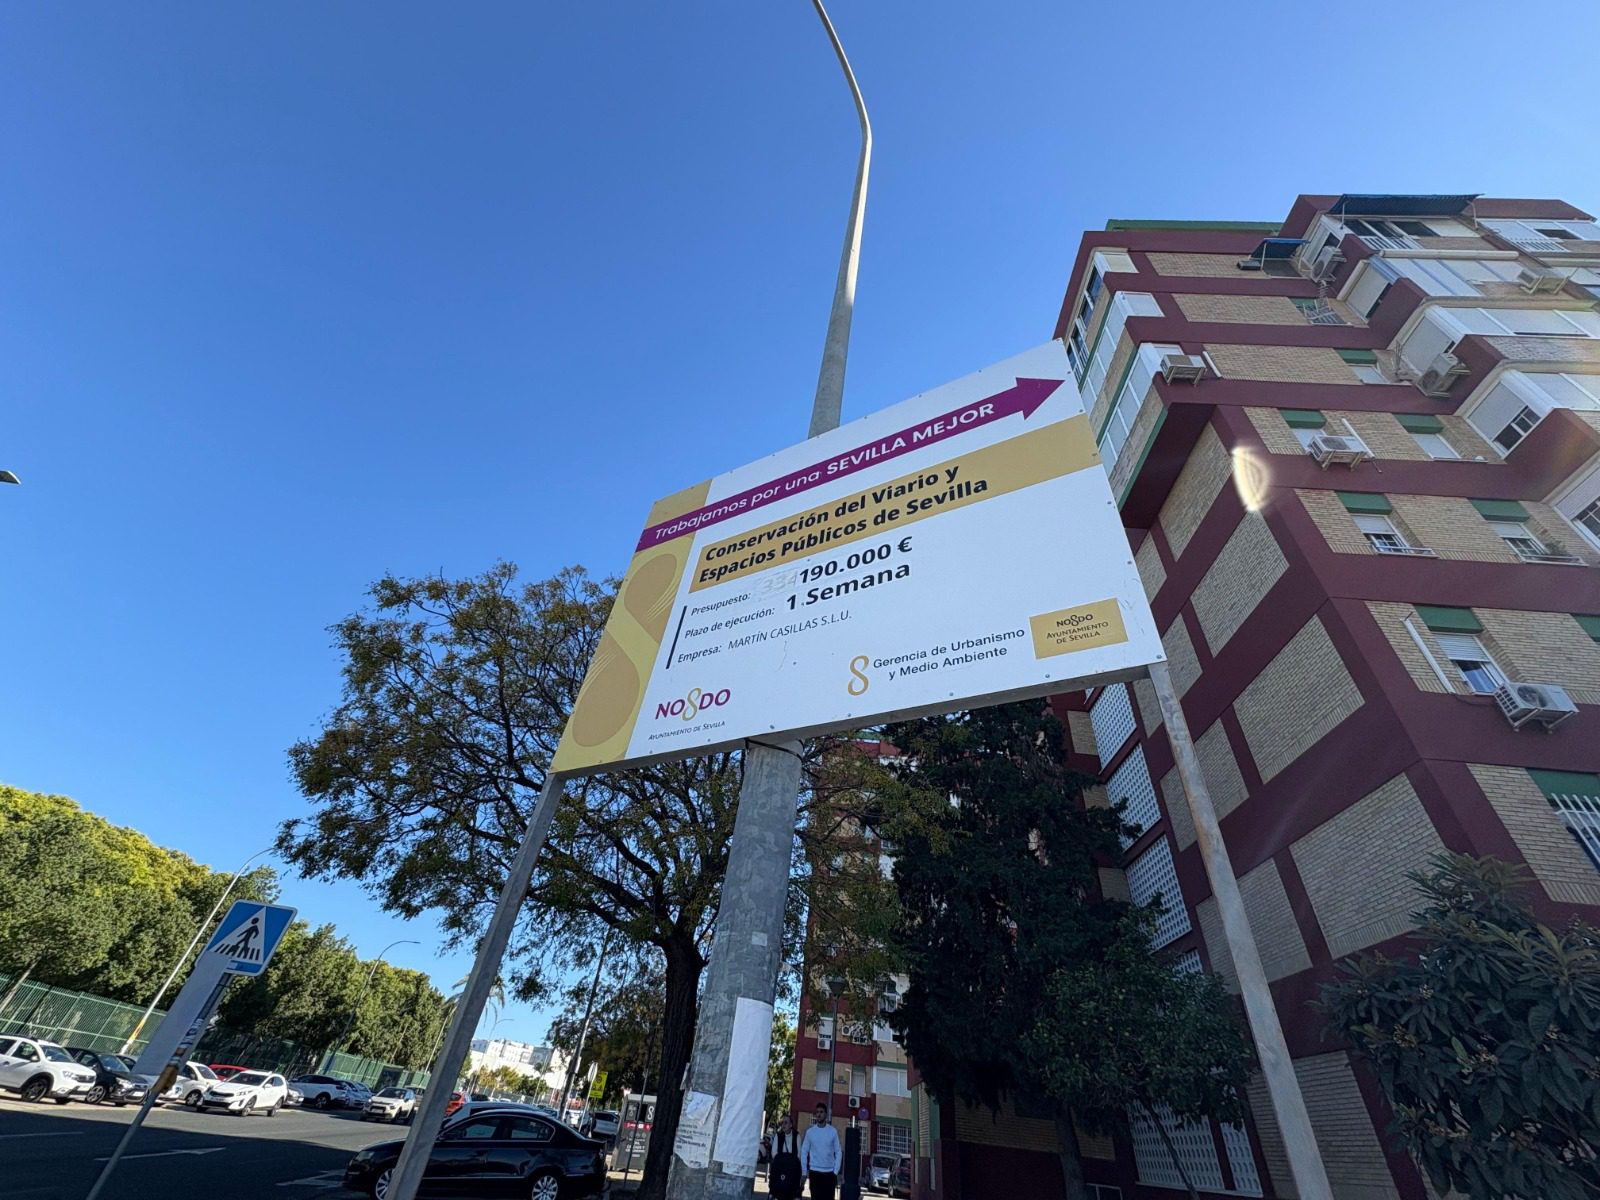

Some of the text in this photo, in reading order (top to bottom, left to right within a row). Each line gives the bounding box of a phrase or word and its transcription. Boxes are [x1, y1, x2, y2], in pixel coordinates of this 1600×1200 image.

[655, 403, 995, 540] Trabajamos por una SEVILLA MEJOR
[699, 478, 988, 583] Espacios Públicos de Sevilla
[706, 464, 959, 561] Conservación del Viario y
[685, 563, 910, 639] Plazo de ejecución: 1 Semana
[691, 592, 751, 616] Presupuesto:
[799, 542, 891, 584] 190.000
[897, 536, 913, 552] €
[678, 610, 852, 663] Empresa: MARTÍN CASILLAS S.L.U.
[873, 629, 1025, 669] Gerencia de Urbanismo
[1046, 621, 1109, 639] AYUNTAMIENTO
[1056, 630, 1101, 645] DE SEVILLA
[888, 647, 1008, 681] y Medio Ambiente
[648, 726, 692, 741] AYUNTAMIENTO
[703, 721, 726, 731] SEVILLA
